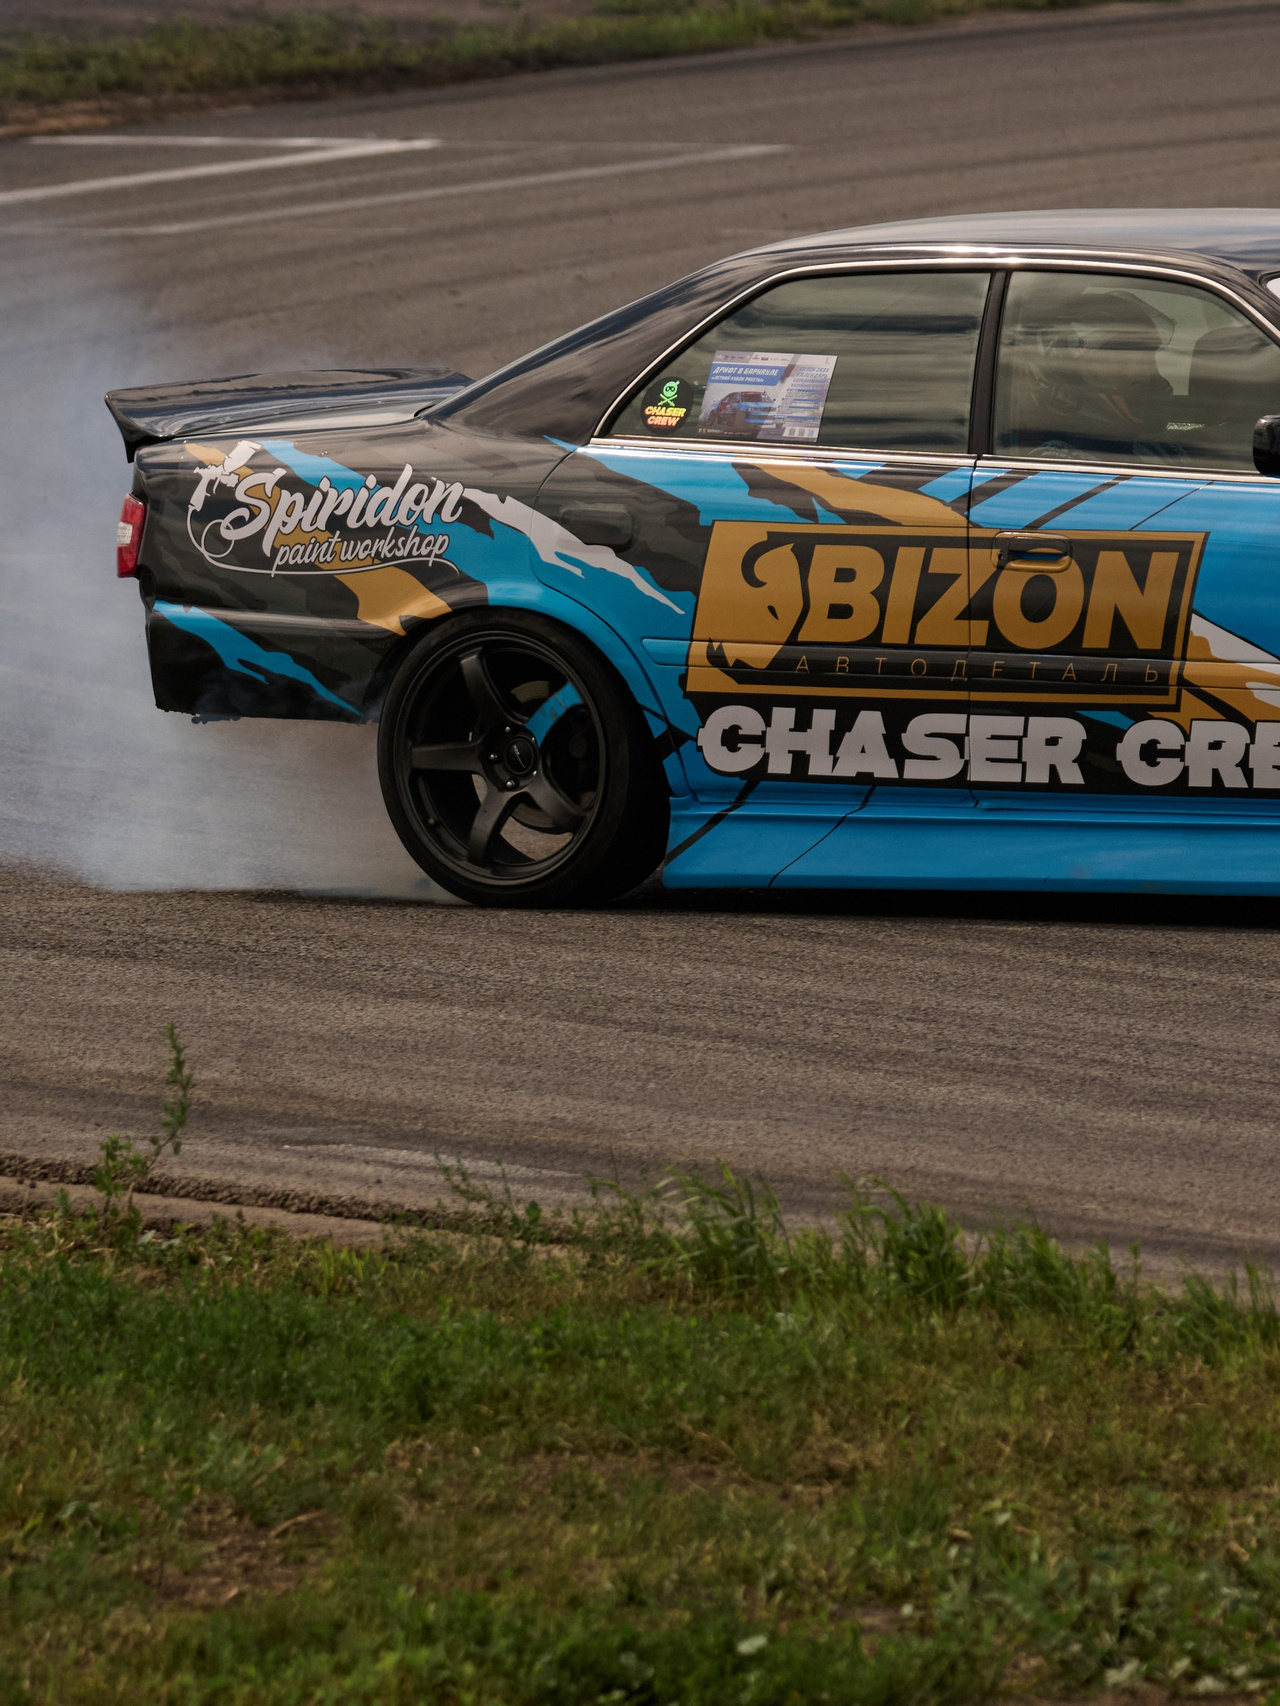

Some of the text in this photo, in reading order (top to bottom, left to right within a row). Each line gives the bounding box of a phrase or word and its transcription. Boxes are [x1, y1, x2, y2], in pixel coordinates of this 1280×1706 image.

[644, 405, 686, 417] CHASER
[647, 416, 680, 427] CREW
[220, 463, 464, 557] Spiridon
[271, 525, 449, 578] paint workshop
[796, 544, 1180, 649] BIZON
[697, 704, 1087, 785] CHASER
